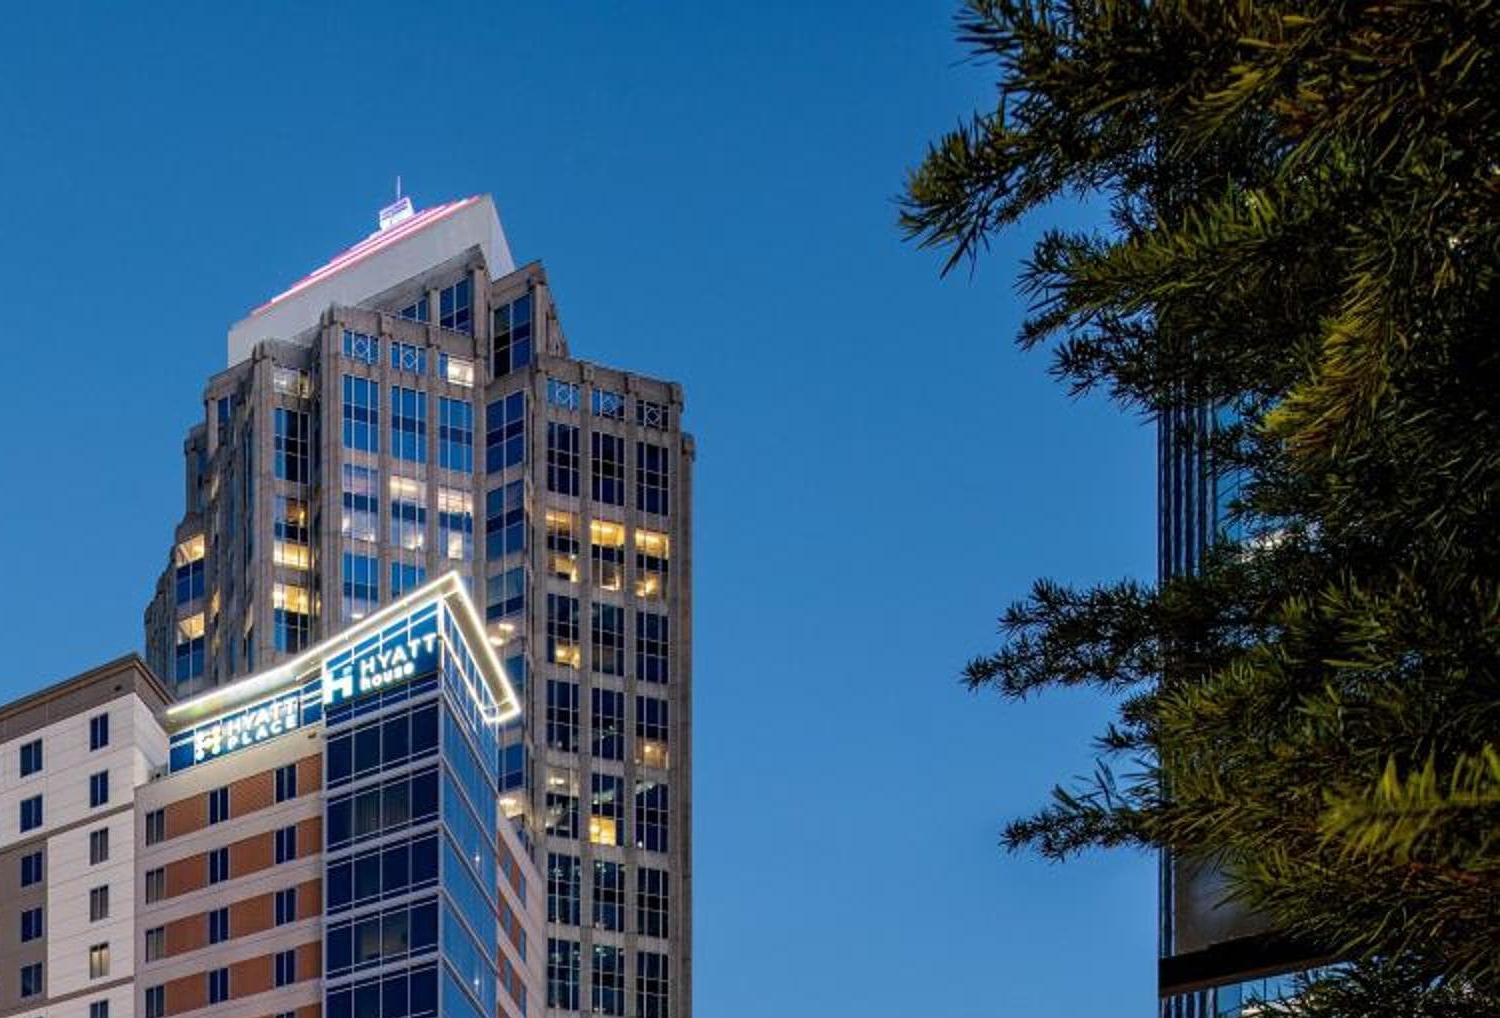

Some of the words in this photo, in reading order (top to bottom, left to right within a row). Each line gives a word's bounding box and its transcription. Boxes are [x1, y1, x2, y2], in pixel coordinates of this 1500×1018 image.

[359, 632, 438, 674] HYATT
[226, 696, 299, 736] HYATT
[227, 715, 298, 750] PLACE
